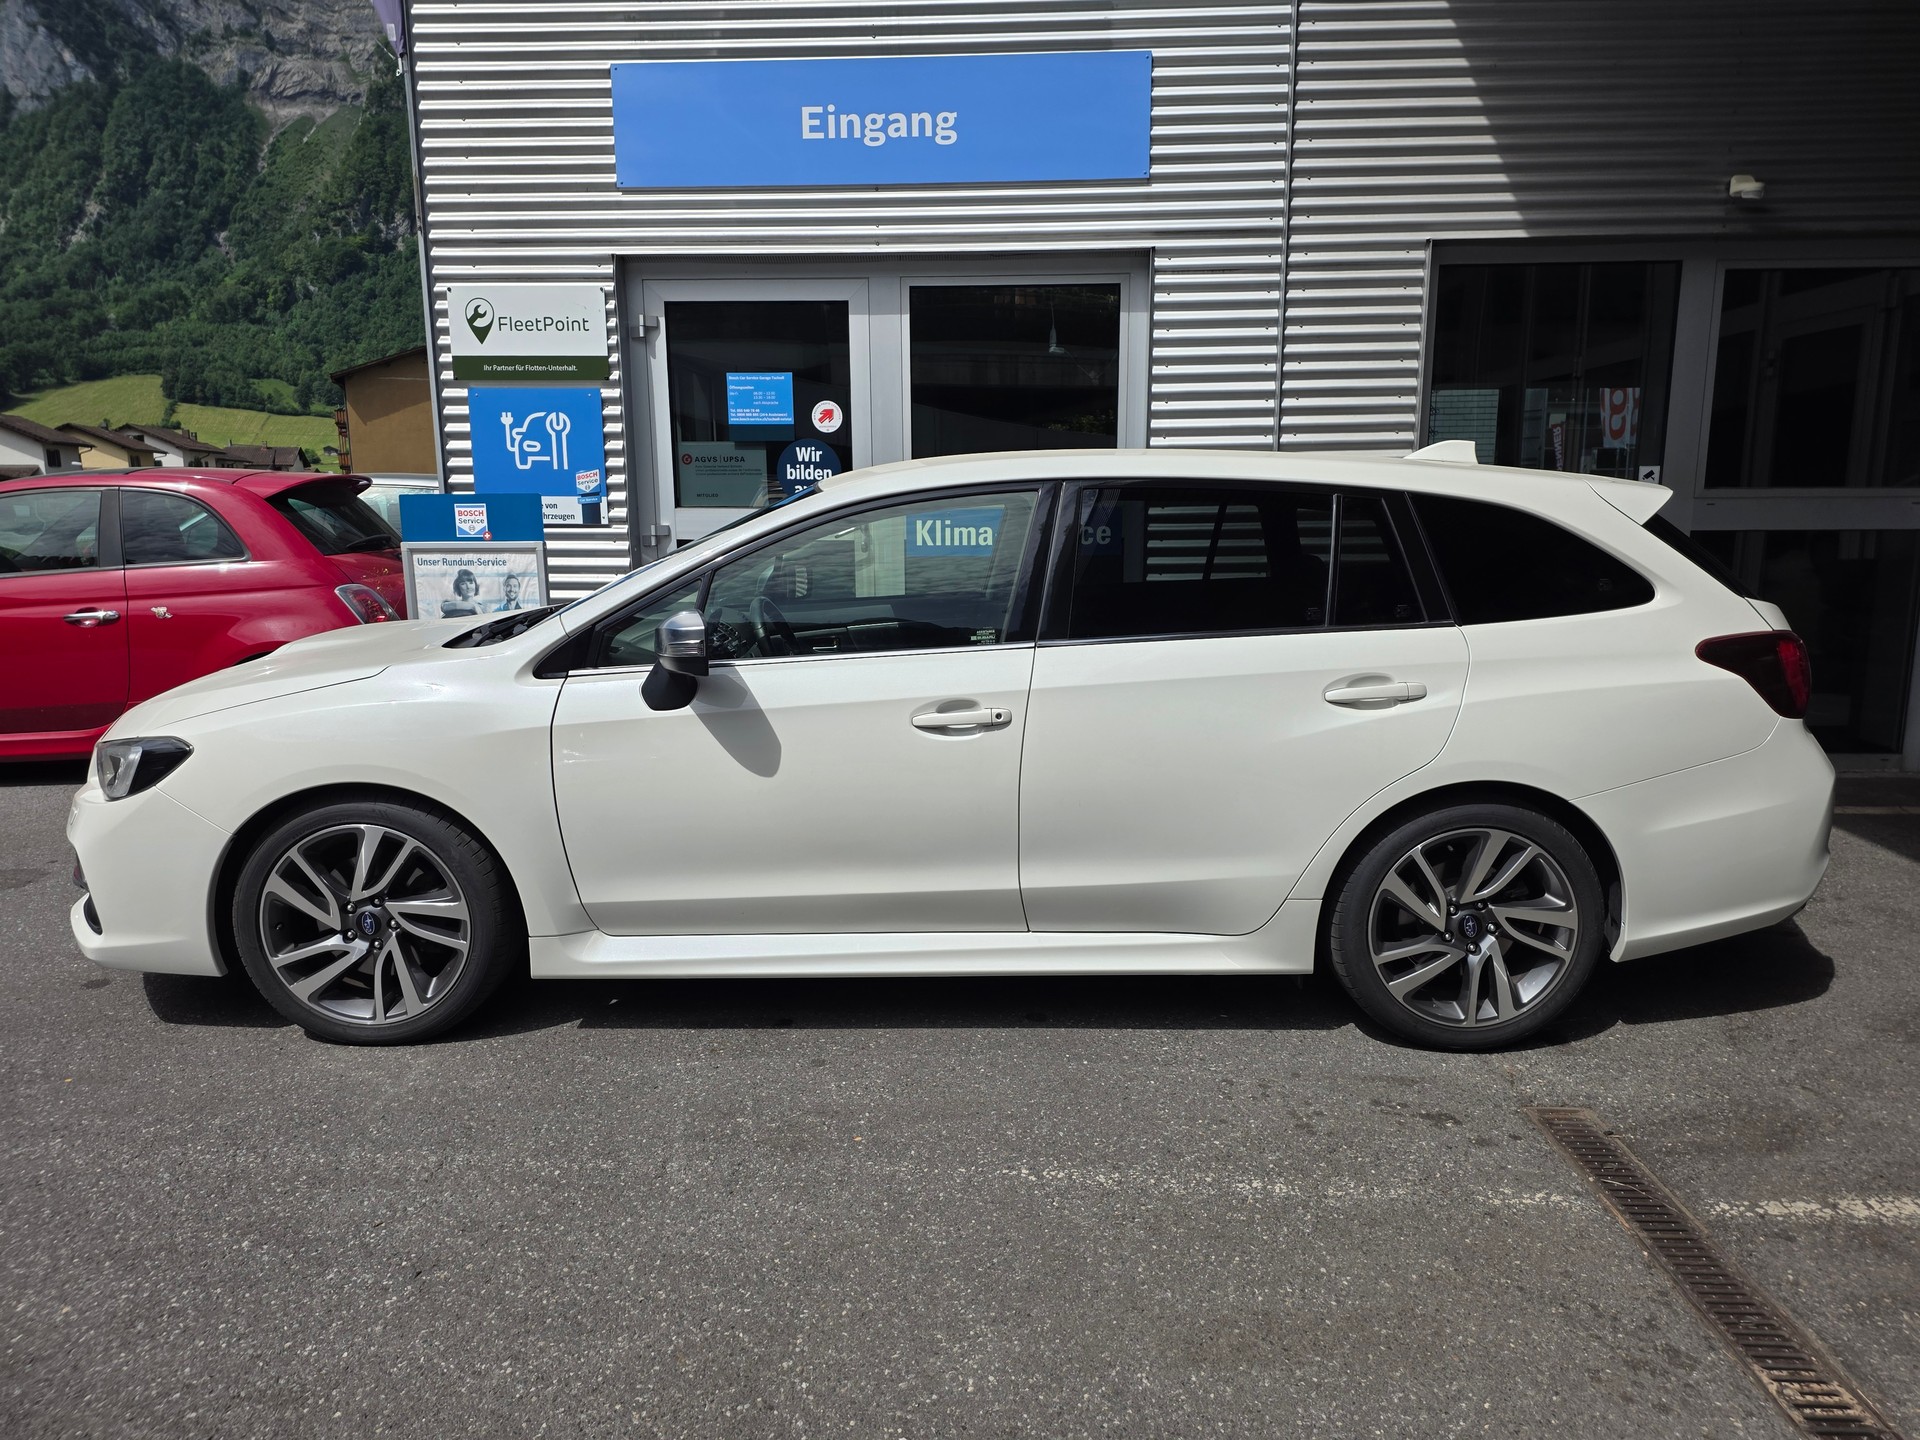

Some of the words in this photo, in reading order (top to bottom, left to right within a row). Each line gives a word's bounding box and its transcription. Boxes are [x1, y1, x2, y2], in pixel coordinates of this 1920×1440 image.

[801, 104, 958, 147] Eingang
[498, 316, 590, 332] FleetPoint
[525, 364, 578, 372] Flotten-Unterhalt.
[795, 446, 823, 462] Wir
[577, 471, 598, 481] BOSCH
[786, 464, 833, 480] bilden
[457, 509, 485, 517] BOSCH
[543, 512, 576, 522] hrzeugen
[417, 557, 440, 567] Unser
[442, 557, 507, 567] Rundum-Service
